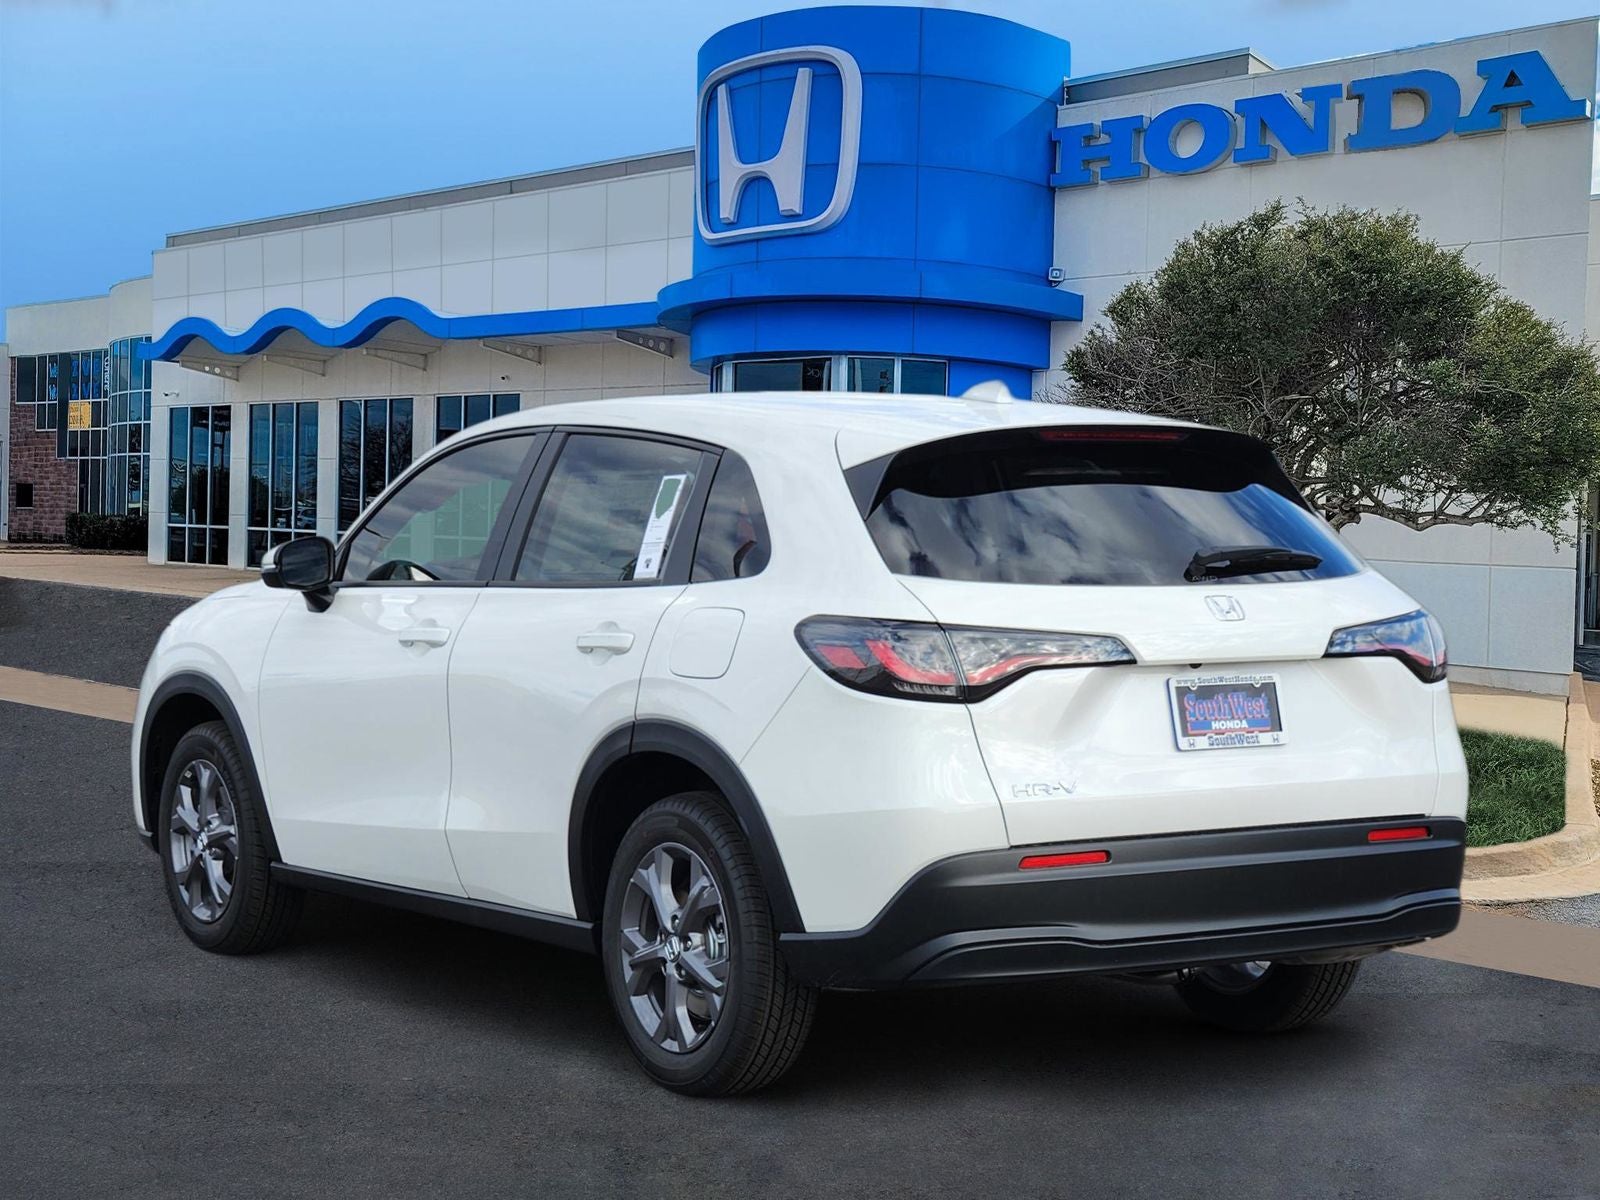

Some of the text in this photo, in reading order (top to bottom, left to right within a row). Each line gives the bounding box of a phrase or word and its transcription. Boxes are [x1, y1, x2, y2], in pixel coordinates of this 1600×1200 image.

[1050, 50, 1591, 188] HONDA
[1184, 692, 1270, 720] SouthWest
[1211, 720, 1248, 729] HONDA
[1208, 734, 1260, 746] SouthWest
[1011, 781, 1077, 798] HR-V
